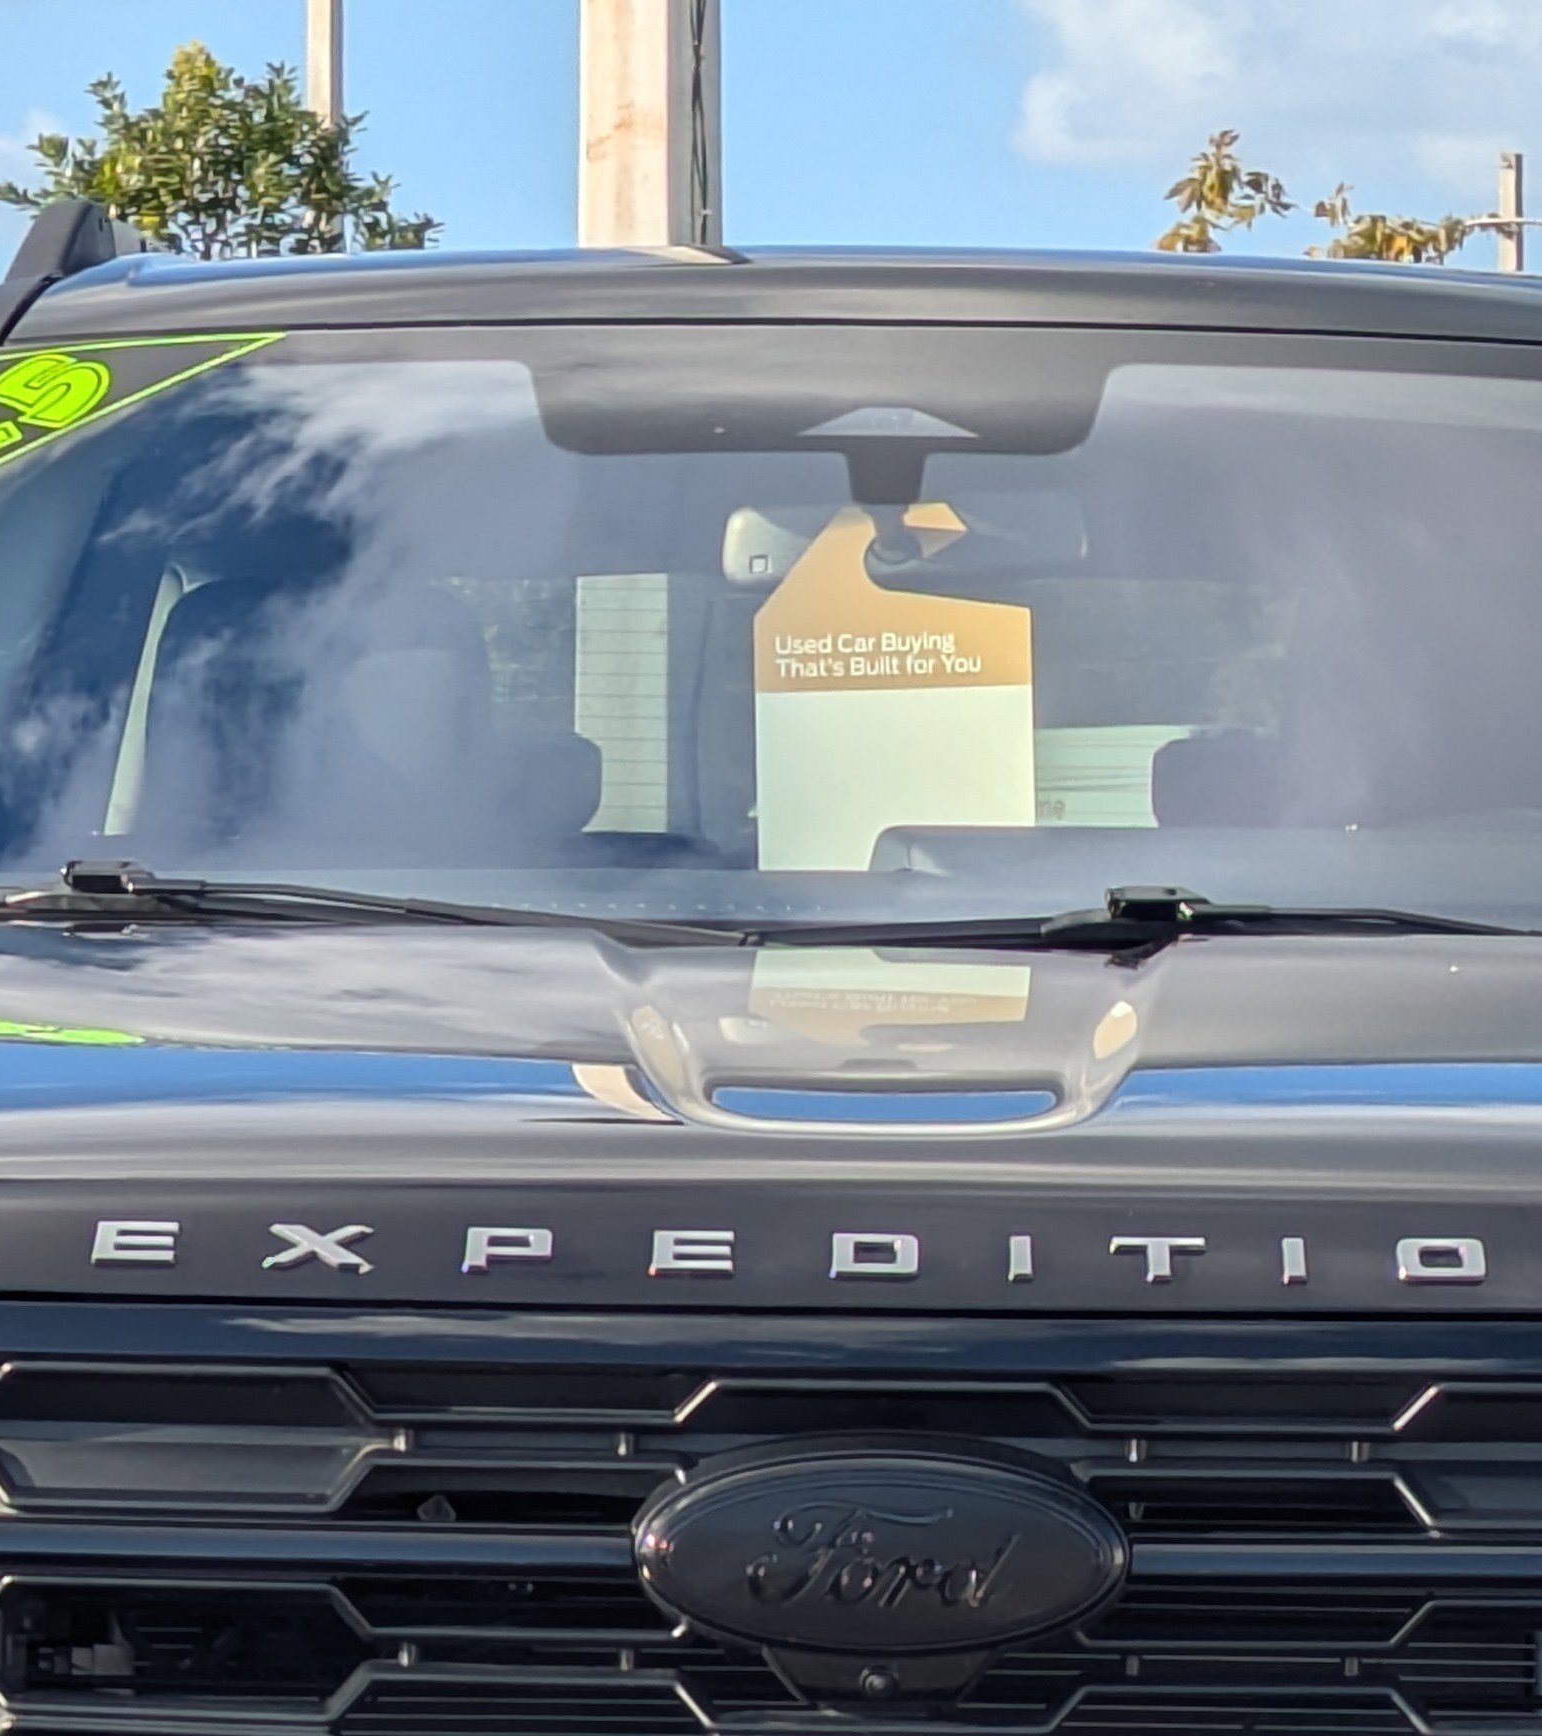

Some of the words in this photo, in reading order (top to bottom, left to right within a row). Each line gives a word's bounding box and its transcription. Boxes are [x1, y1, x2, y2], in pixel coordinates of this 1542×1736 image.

[775, 633, 833, 655] Used
[837, 633, 876, 653] Car
[881, 631, 956, 654] Buying
[775, 657, 845, 678] That's
[850, 655, 900, 677] Built
[906, 654, 936, 674] for
[941, 653, 983, 674] You
[745, 1499, 1023, 1608] Ford
